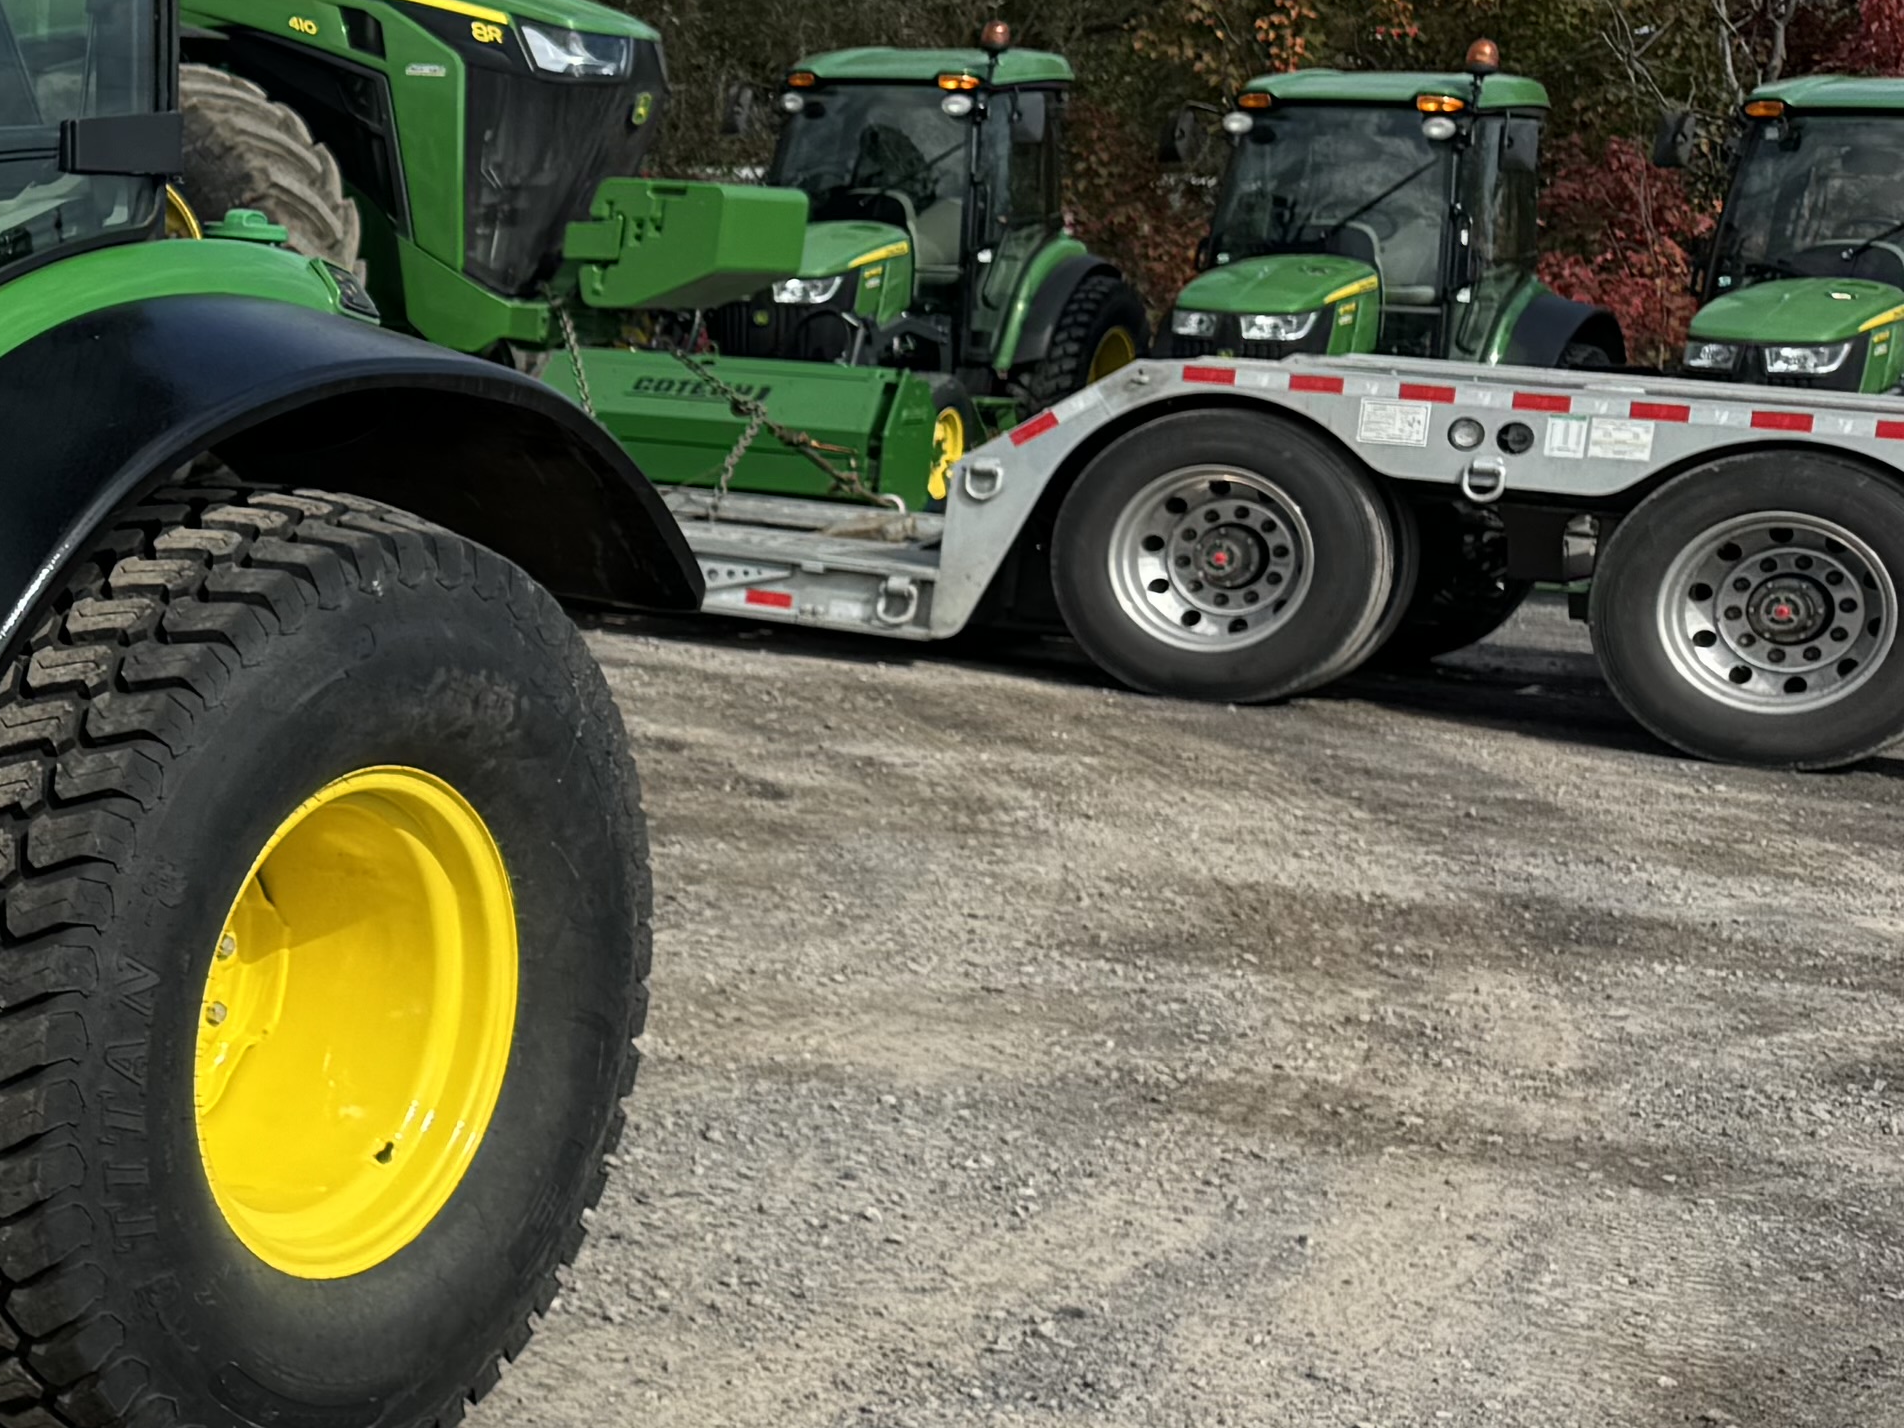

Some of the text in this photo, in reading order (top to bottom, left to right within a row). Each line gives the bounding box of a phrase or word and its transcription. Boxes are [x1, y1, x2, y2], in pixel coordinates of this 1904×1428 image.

[288, 16, 318, 35] 410
[471, 21, 505, 45] 8R
[96, 955, 160, 1254] TITAN
